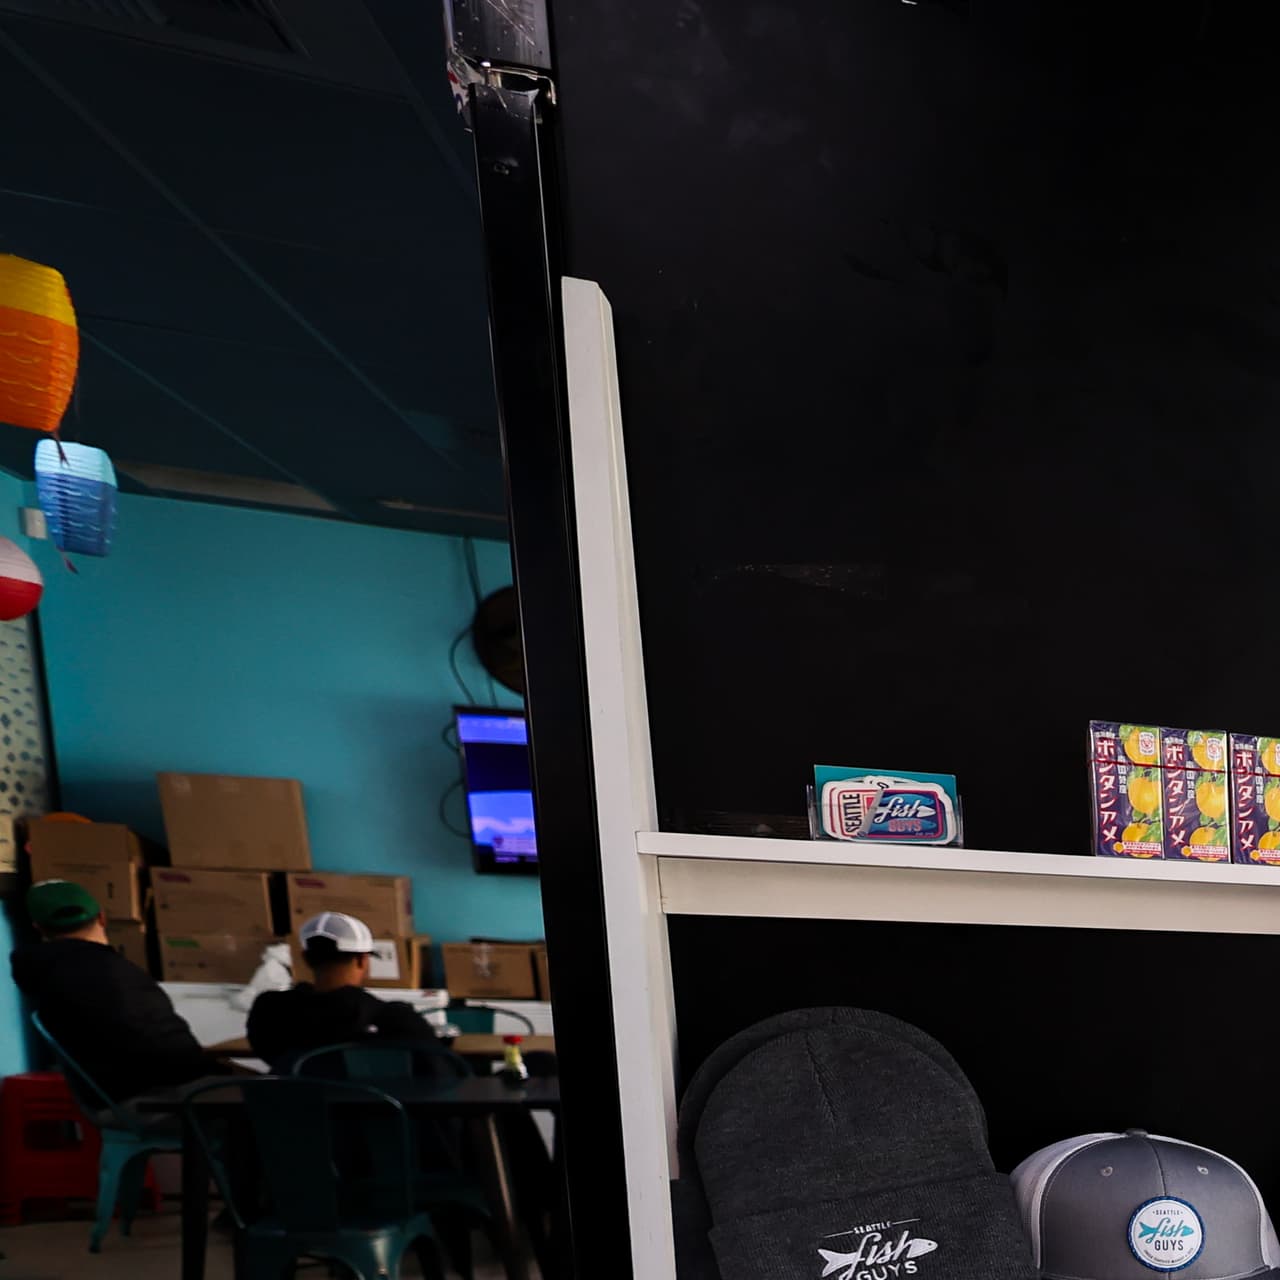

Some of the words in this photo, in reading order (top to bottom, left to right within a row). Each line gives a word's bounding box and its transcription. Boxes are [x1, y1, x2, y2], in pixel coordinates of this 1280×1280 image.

[1095, 739, 1118, 842] ボンタンアメ
[1165, 745, 1187, 847] ボンタンアメ
[1235, 752, 1255, 850] ボンタンアメ
[842, 793, 863, 833] SEATTLE
[853, 1221, 892, 1235] SEATTLE
[1143, 1217, 1188, 1244] fish
[1154, 1239, 1184, 1251] GUYS
